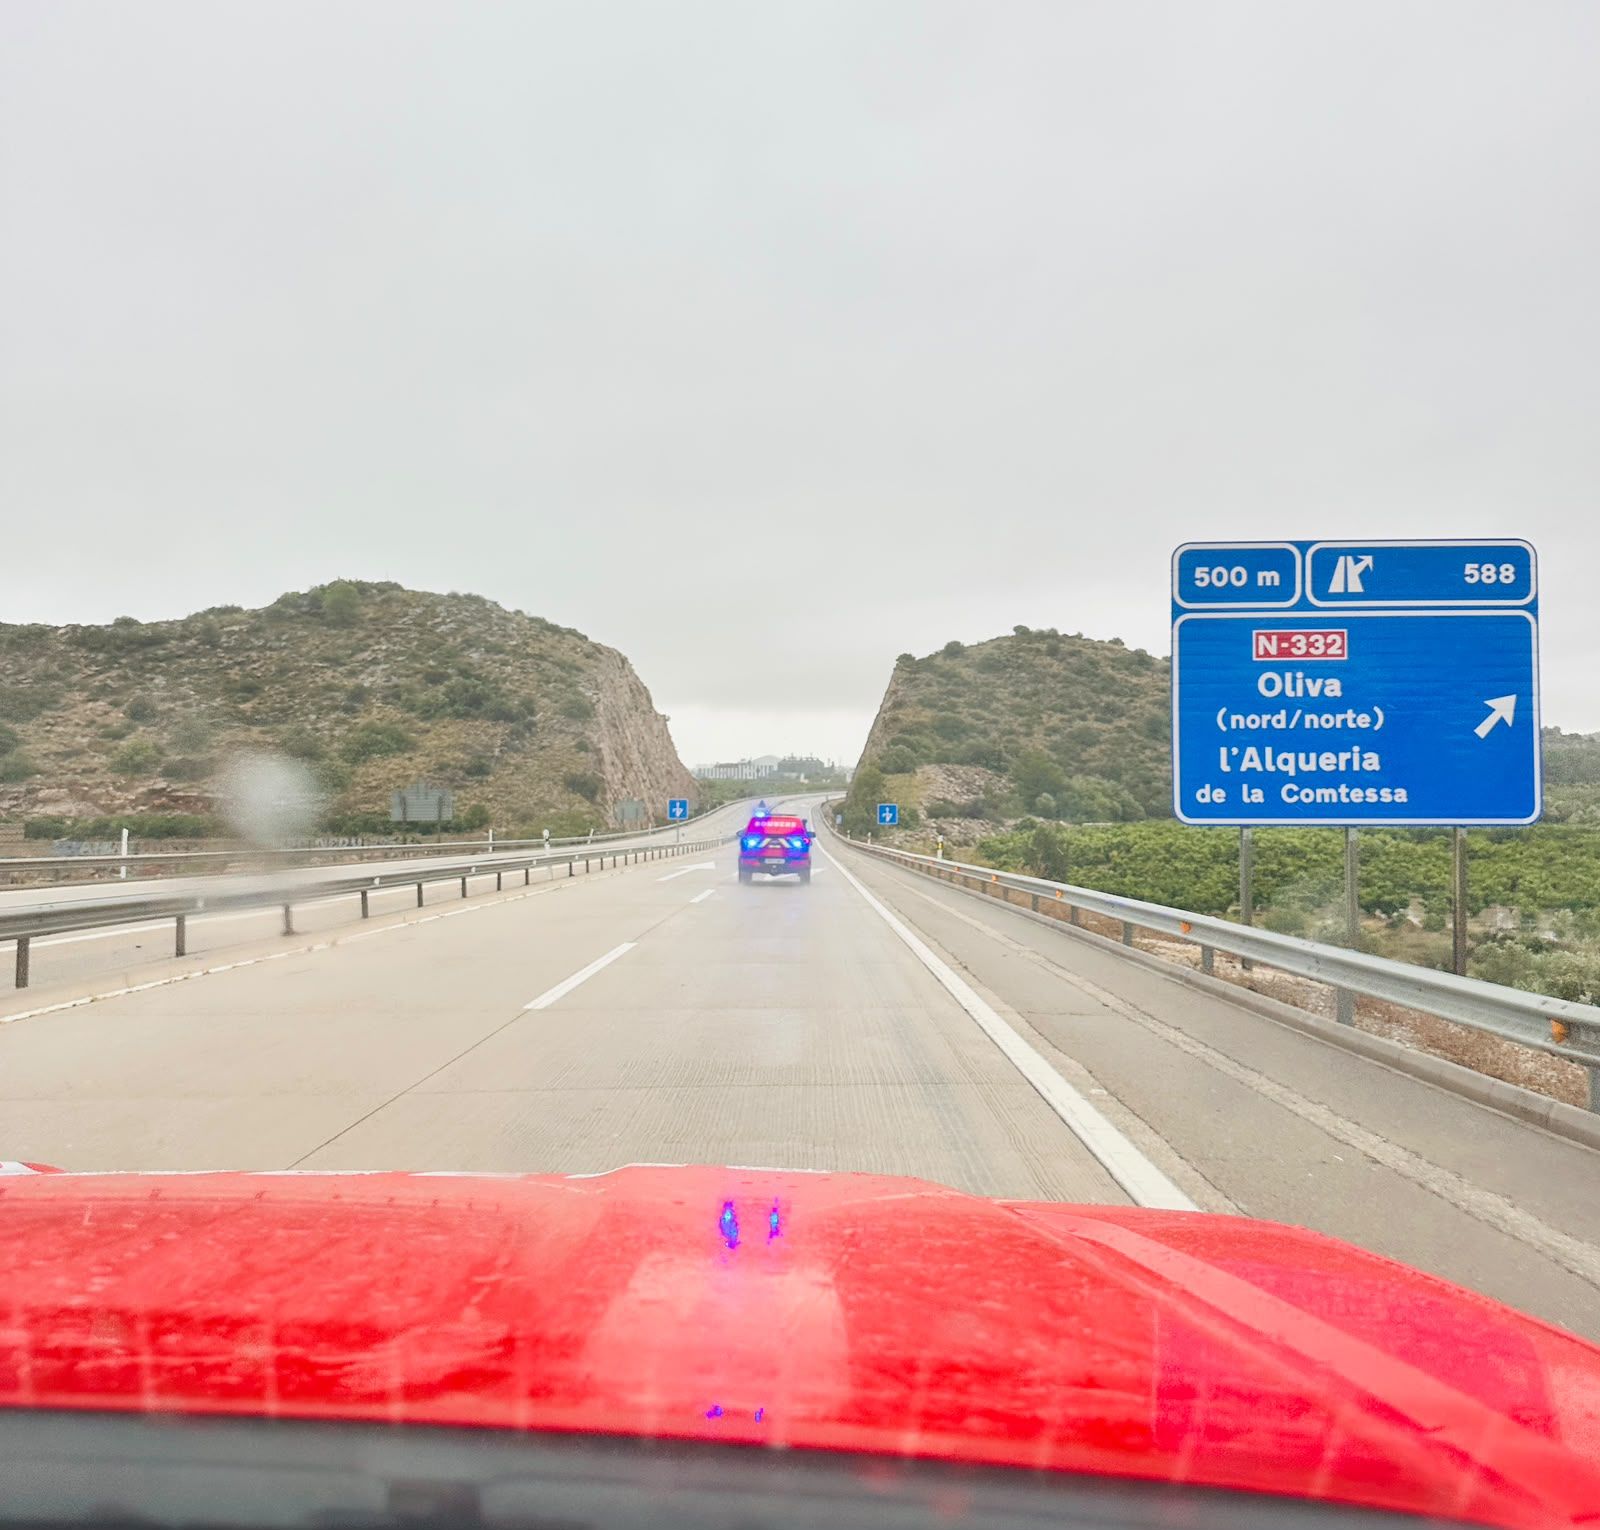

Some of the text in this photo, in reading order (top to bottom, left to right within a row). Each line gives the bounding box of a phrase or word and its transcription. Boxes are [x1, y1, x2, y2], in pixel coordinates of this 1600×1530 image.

[1194, 567, 1280, 586] 500 m
[1464, 564, 1516, 583] 588
[1257, 634, 1342, 656] N-332
[1257, 672, 1342, 698] Oliva
[1216, 706, 1384, 731] (nord/norte)
[1195, 784, 1408, 803] de la Comtessa
